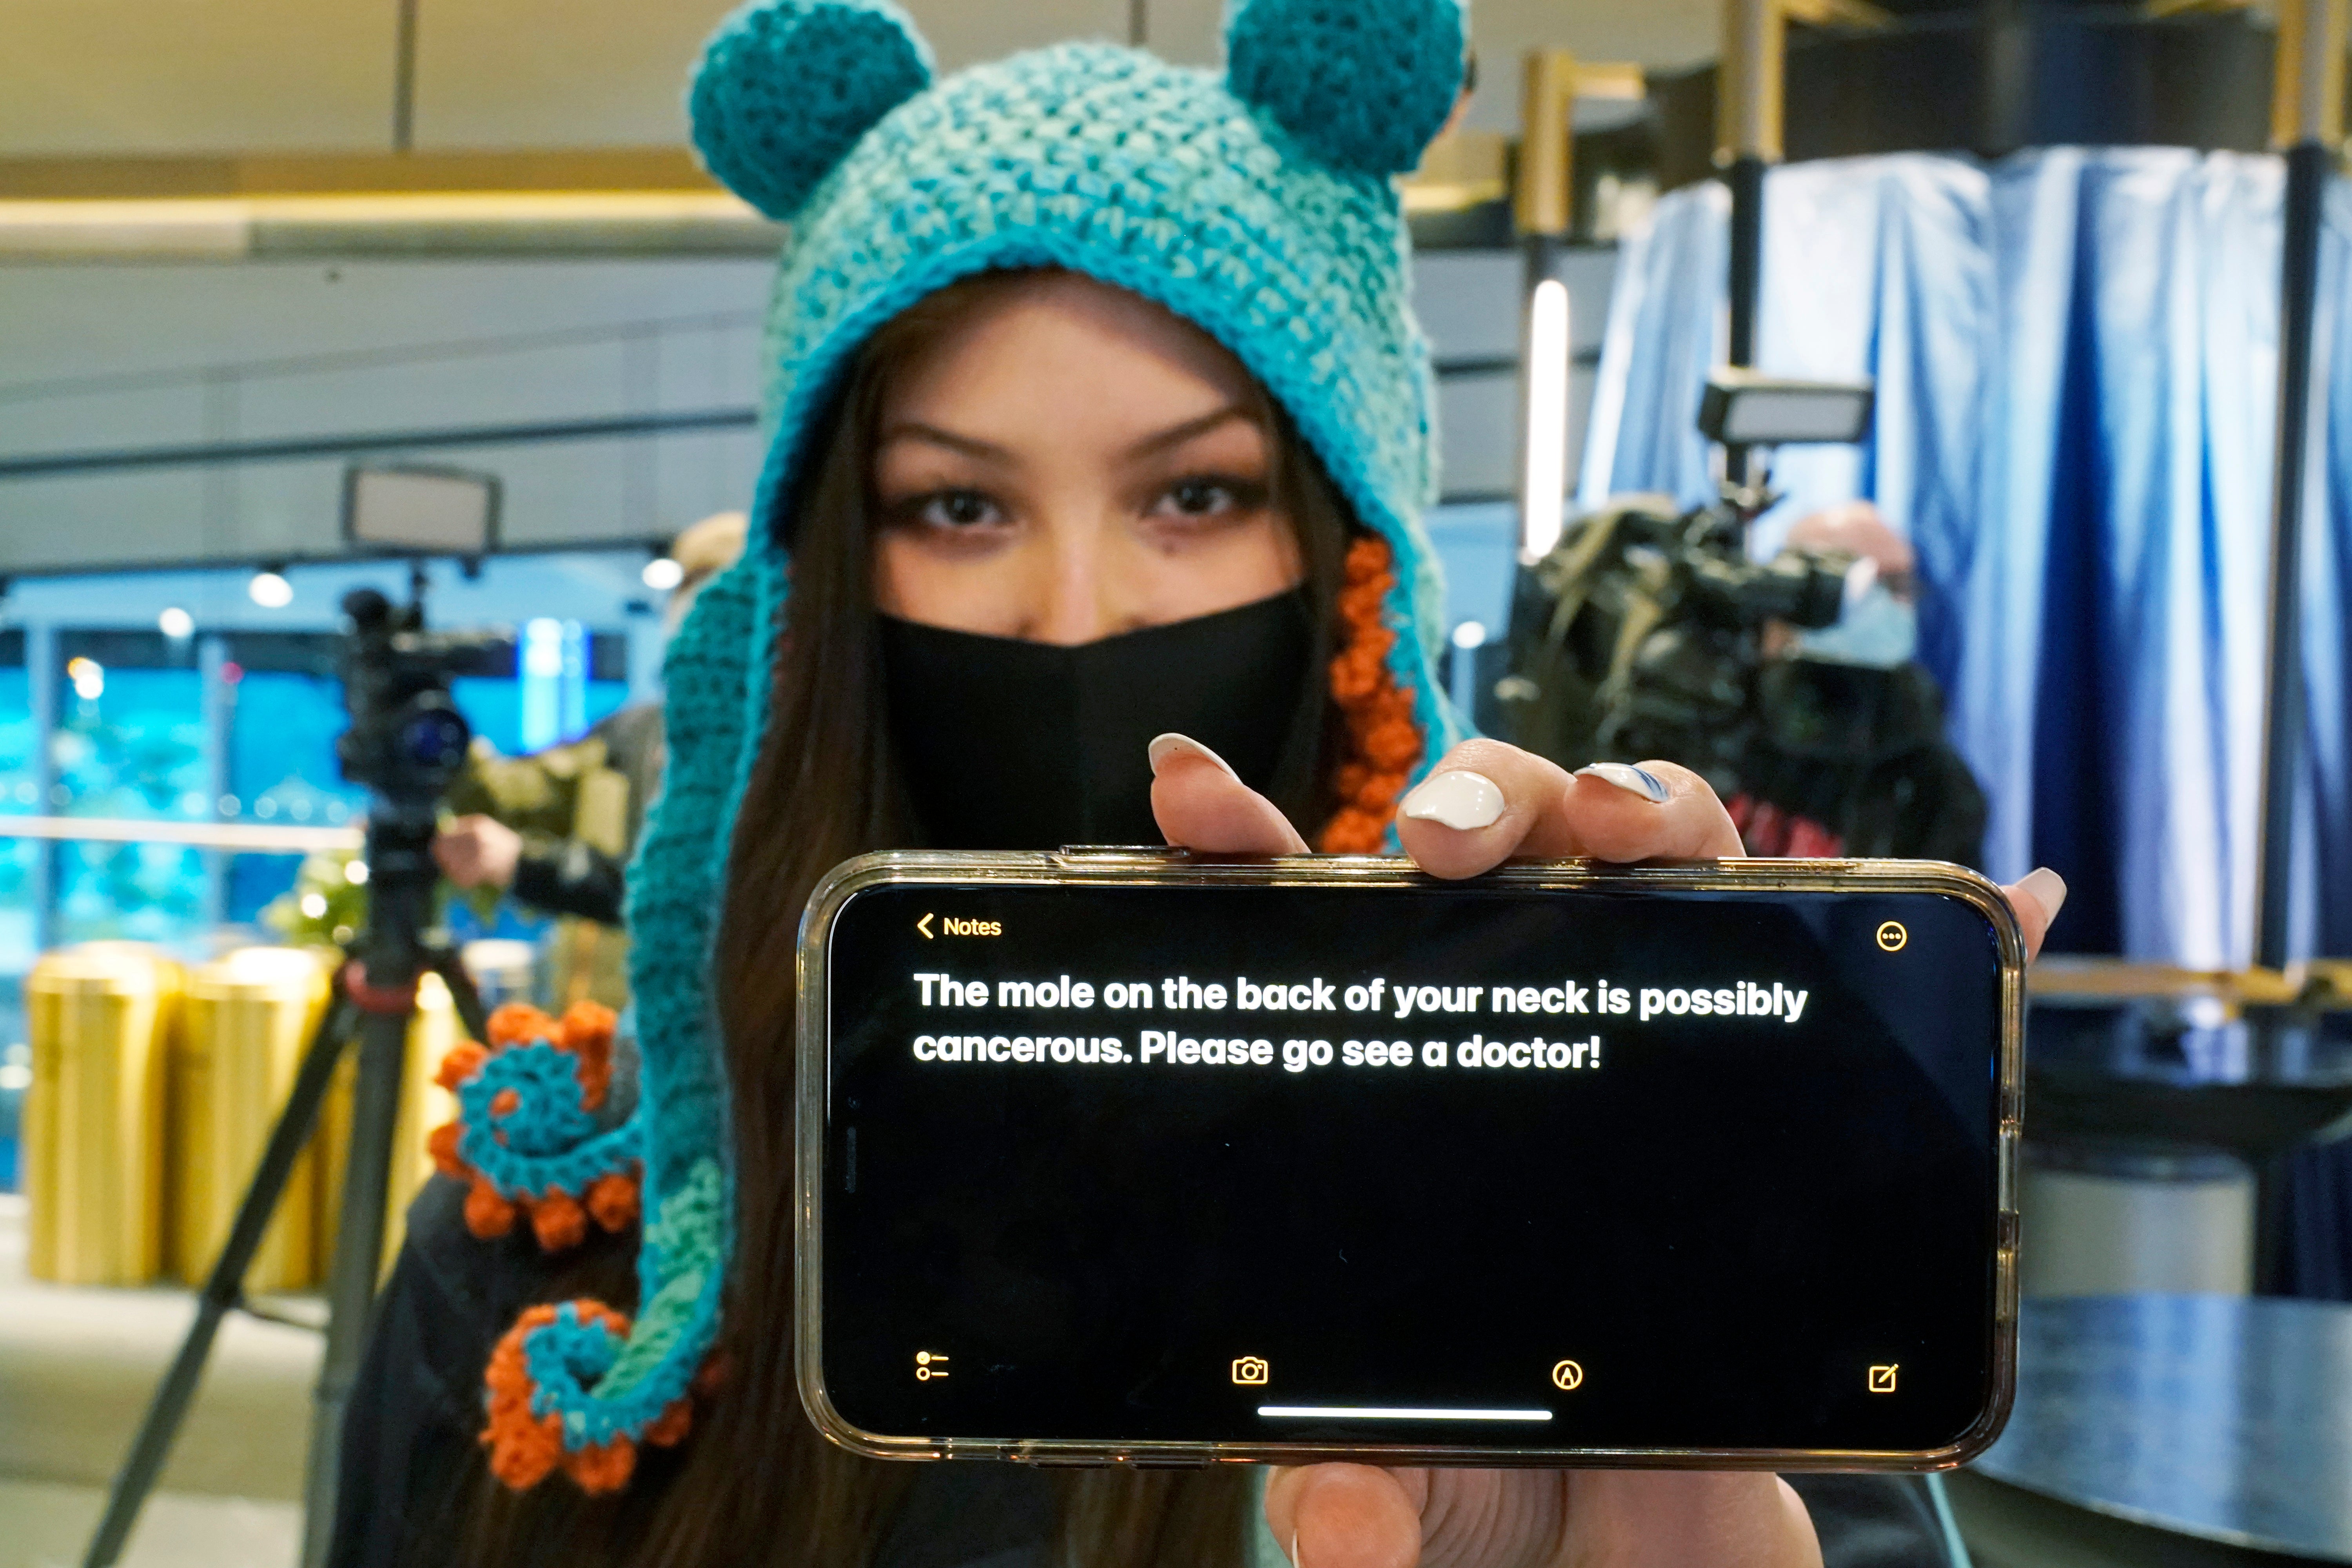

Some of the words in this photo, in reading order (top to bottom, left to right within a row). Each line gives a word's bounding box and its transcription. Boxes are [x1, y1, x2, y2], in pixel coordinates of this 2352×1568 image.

[943, 917, 1002, 936] Notes
[913, 973, 989, 1007] The
[998, 974, 1095, 1009] mole
[1103, 982, 1153, 1009] on
[1161, 976, 1228, 1010] the
[1237, 976, 1337, 1011] back
[1344, 977, 1385, 1012] of
[1392, 985, 1484, 1019] your
[1492, 980, 1590, 1014] neck
[1597, 978, 1631, 1014] is
[1639, 980, 1809, 1023] possibly
[913, 1032, 1132, 1064] cancerous.
[1140, 1030, 1274, 1065] Please
[1282, 1039, 1334, 1073] go
[1341, 1040, 1414, 1067] see
[1421, 1040, 1448, 1067] a
[1456, 1034, 1601, 1069] doctor!
